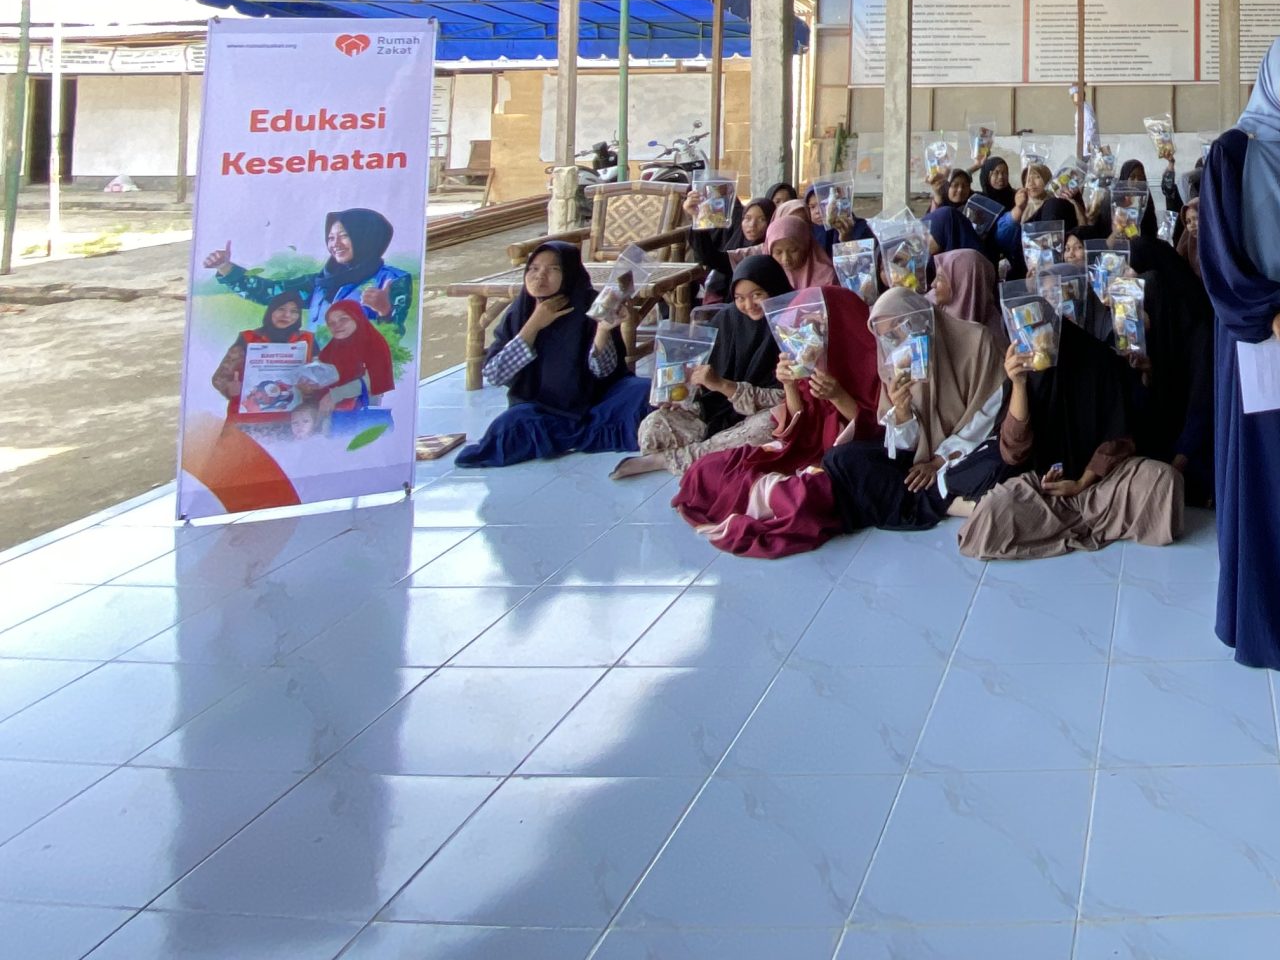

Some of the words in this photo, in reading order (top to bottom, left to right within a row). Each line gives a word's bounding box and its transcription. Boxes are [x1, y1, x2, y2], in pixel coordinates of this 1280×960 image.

[377, 36, 420, 46] Rumah
[377, 46, 412, 55] Zakat
[250, 107, 386, 133] Edukasi
[221, 150, 407, 176] Kesehatan
